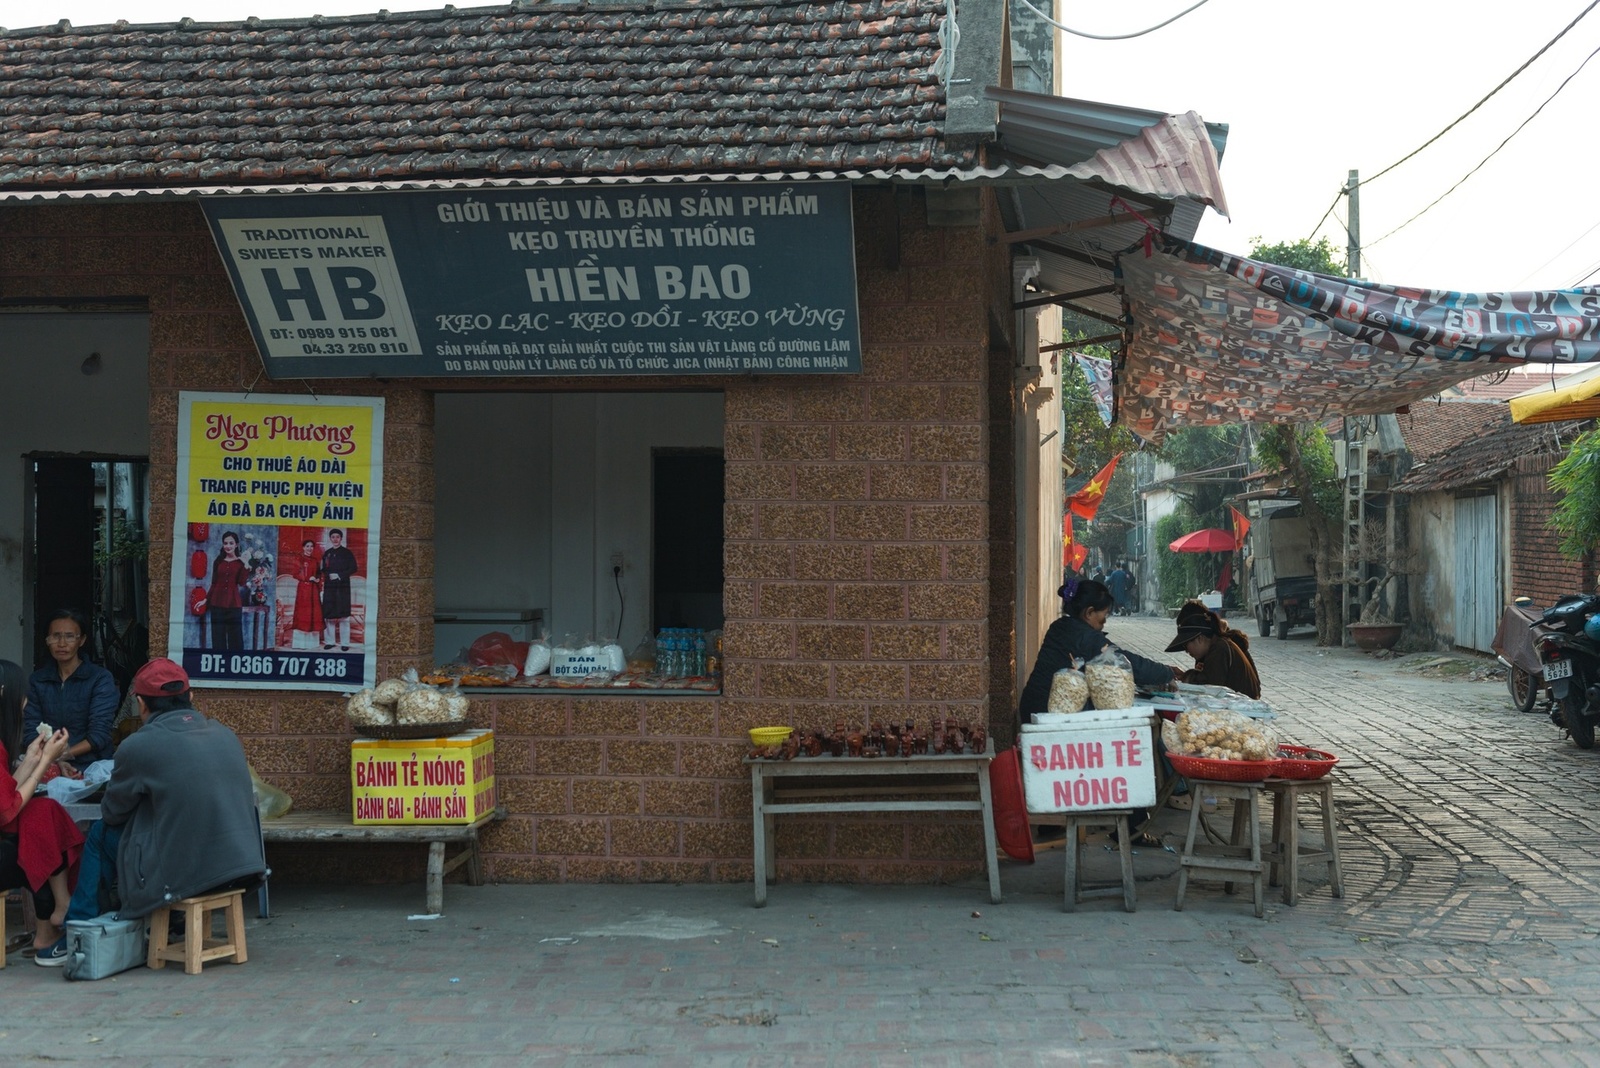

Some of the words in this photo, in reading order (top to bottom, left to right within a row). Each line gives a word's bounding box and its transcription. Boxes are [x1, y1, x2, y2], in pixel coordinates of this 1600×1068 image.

[436, 198, 490, 222] GIỚI
[496, 197, 570, 224] THIỆU
[576, 196, 611, 219] VÀ
[618, 194, 672, 218] BÁN
[680, 189, 734, 217] SẢN
[742, 188, 818, 216] PHẨM
[241, 226, 370, 241] TRADITIONAL
[508, 230, 559, 254] KẸO
[564, 222, 664, 249] TRUYỀN
[670, 220, 756, 247] THỐNG
[238, 246, 314, 260] SWEETS
[318, 246, 387, 258] MAKER
[525, 254, 642, 302] HIỀN
[654, 263, 752, 300] BAO
[261, 266, 386, 322] HB
[436, 314, 492, 336] KẸO
[498, 313, 549, 334] LẠC
[568, 312, 626, 334] KẸO
[631, 304, 682, 328] DỒI
[702, 310, 759, 332] KẸO
[765, 302, 846, 331] VỪNG
[270, 328, 294, 340] ĐT:
[298, 328, 334, 339] 0989
[340, 327, 367, 338] 915
[370, 326, 398, 338] 081
[302, 343, 344, 355] 04.33
[348, 343, 377, 354] 260
[380, 342, 408, 354] 910
[436, 341, 462, 356] SẢN
[464, 340, 500, 355] PHẨM
[502, 342, 519, 355] ĐÃ
[522, 343, 545, 357] ĐẠT
[548, 339, 574, 354] GIẢI
[577, 339, 608, 354] NHẤT
[611, 340, 644, 354] CUỘC
[646, 342, 667, 353] THI
[670, 337, 696, 353] SẢN
[698, 339, 720, 354] VẬT
[724, 338, 756, 352] LÀNG
[759, 337, 776, 352] CỔ
[779, 338, 820, 352] ĐƯỜNG
[824, 338, 850, 352] LÂM
[445, 360, 461, 371] DO
[465, 360, 490, 371] BAN
[492, 356, 526, 371] QUẢN
[528, 354, 542, 370] LÝ
[546, 356, 577, 370] LÀNG
[580, 355, 597, 370] CỔ
[600, 356, 616, 370] VÀ
[636, 355, 669, 369] CHỨC
[673, 358, 701, 369] JICA
[704, 355, 739, 370] (NHẬT
[743, 353, 773, 369] BẢN)
[776, 355, 810, 368] CÔNG
[814, 355, 848, 370] NHẬN
[206, 414, 258, 452] Nga
[263, 415, 356, 455] Phương
[223, 456, 253, 471] CHO
[256, 455, 293, 472] THUÊ
[296, 455, 317, 473] ÁO
[320, 456, 346, 474] DÀI
[200, 479, 247, 494] TRANG
[251, 481, 290, 498] PHỤC
[294, 482, 324, 500] PHỤ
[328, 480, 363, 501] KIỆN
[207, 500, 227, 516] ÁO
[231, 500, 251, 517] BÀ
[255, 503, 275, 518] BA
[279, 504, 319, 522] CHỤP
[322, 501, 354, 520] ẢNH
[200, 654, 226, 672] ĐT:
[230, 656, 273, 675] 0366
[278, 657, 310, 676] 707
[314, 658, 347, 677] 388
[1111, 730, 1142, 767] TẺ
[356, 756, 397, 787] BÁNH
[401, 752, 419, 786] TẺ
[423, 755, 465, 786] NÓNG
[356, 793, 384, 819] BÁNH
[387, 797, 404, 819] GAI
[414, 792, 442, 819] BÁNH
[445, 788, 466, 818] SẮN
[1053, 773, 1128, 807] NÓNG
